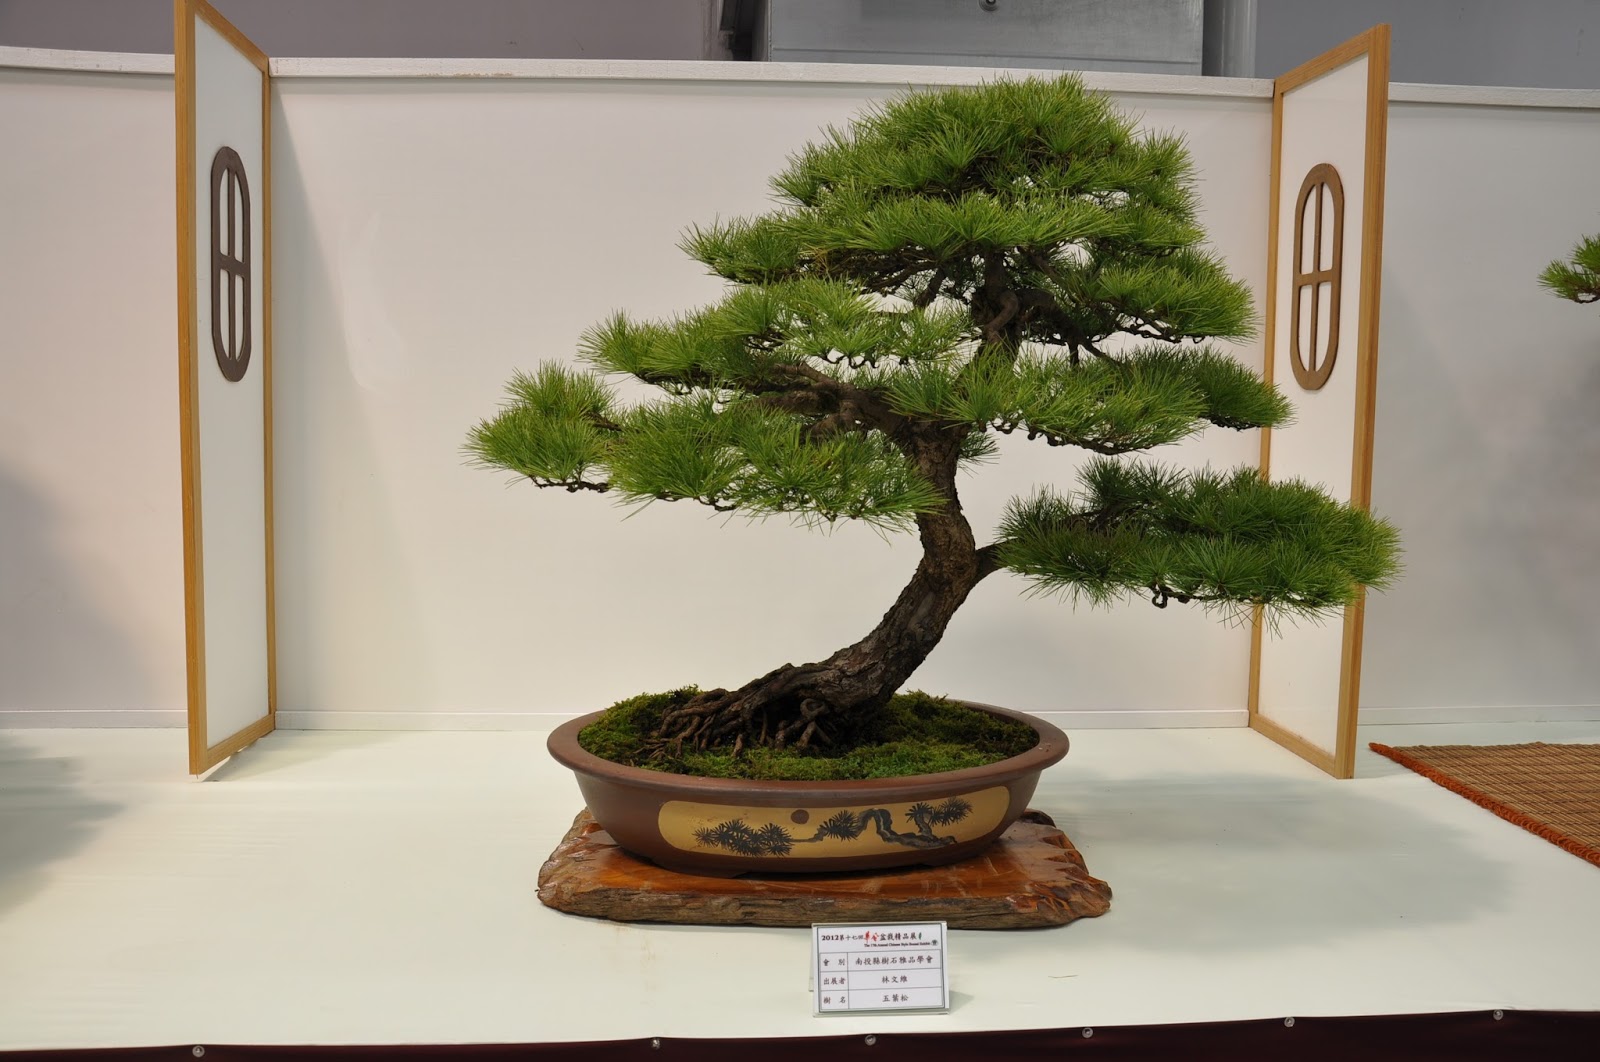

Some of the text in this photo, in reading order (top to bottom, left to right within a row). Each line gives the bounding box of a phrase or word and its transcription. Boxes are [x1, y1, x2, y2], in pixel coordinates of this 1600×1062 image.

[823, 977, 846, 985] 出展者
[882, 994, 909, 1003] 五葉松
